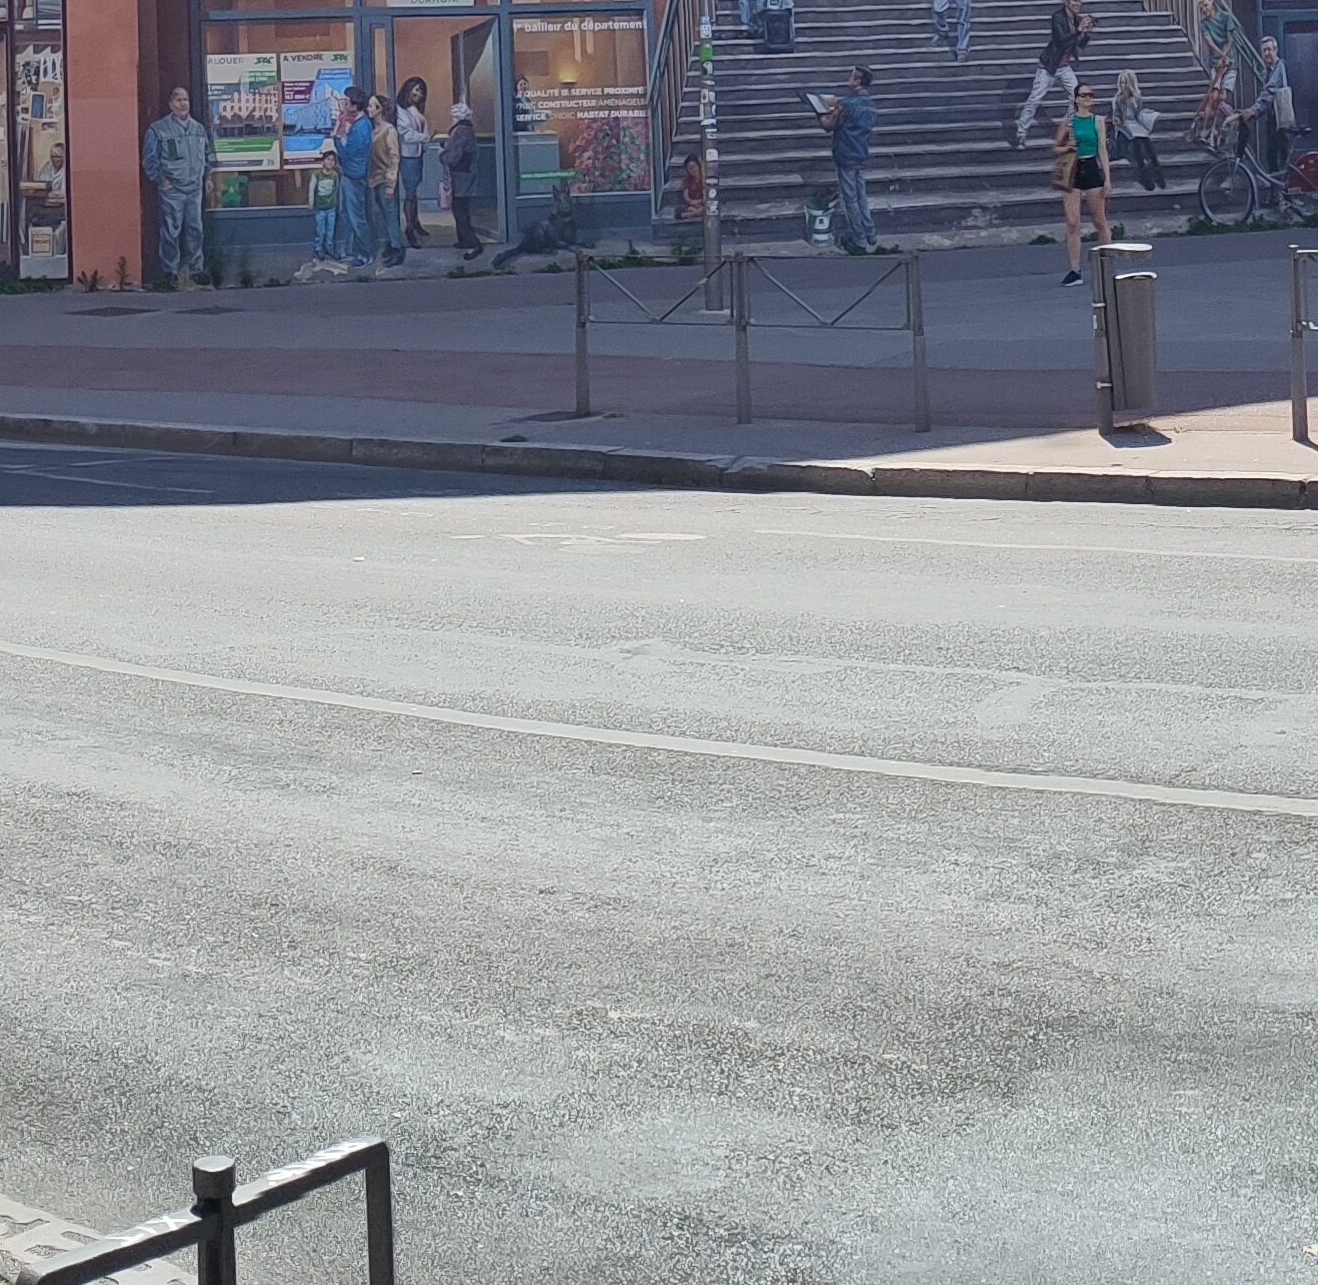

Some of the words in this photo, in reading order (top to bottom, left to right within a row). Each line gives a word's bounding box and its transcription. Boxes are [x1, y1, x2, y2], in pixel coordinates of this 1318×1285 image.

[525, 22, 562, 32] bailleur
[564, 20, 579, 30] du
[291, 53, 324, 63] VENDRE
[524, 89, 560, 98] QUALITÉ
